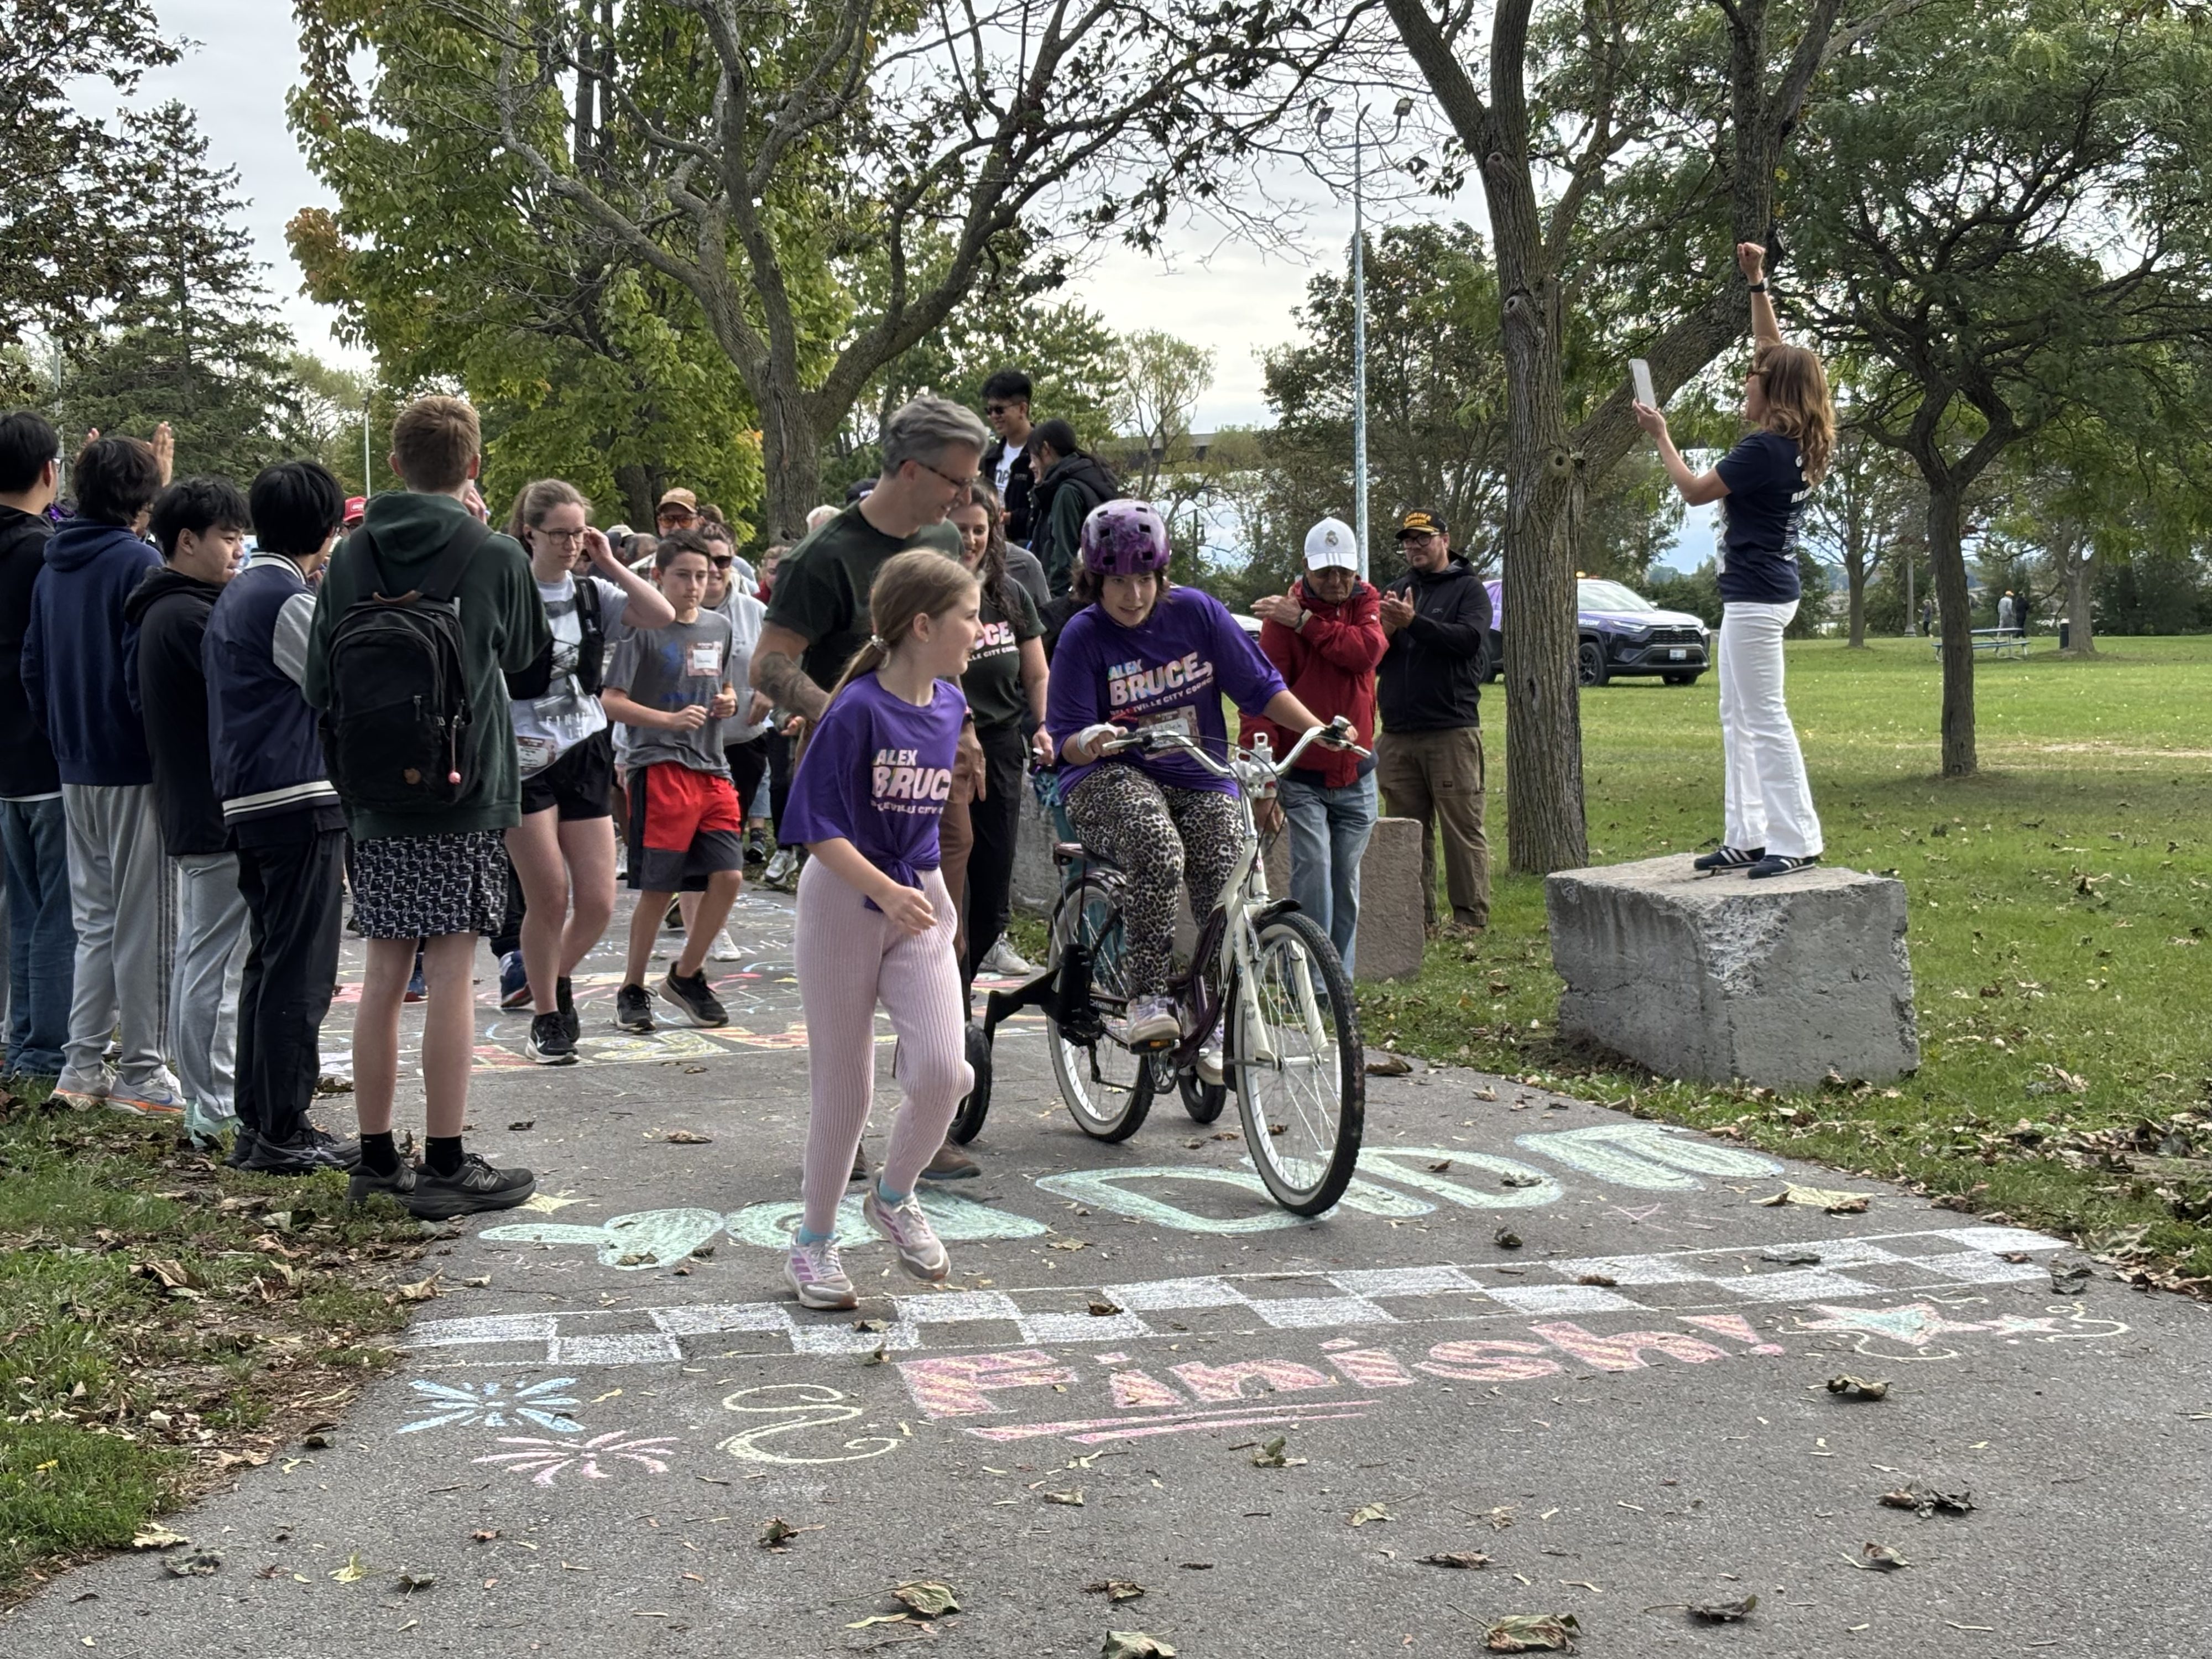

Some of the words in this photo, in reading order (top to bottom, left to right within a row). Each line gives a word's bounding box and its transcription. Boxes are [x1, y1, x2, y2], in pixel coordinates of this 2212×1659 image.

[983, 648, 1000, 657] CITY
[1108, 659, 1144, 681] ALEX
[1110, 651, 1212, 706] BRUCE
[1163, 690, 1184, 704] CITY
[872, 749, 919, 766] ALEX
[917, 805, 938, 815] CITY
[894, 1313, 1785, 1419] Finish!
